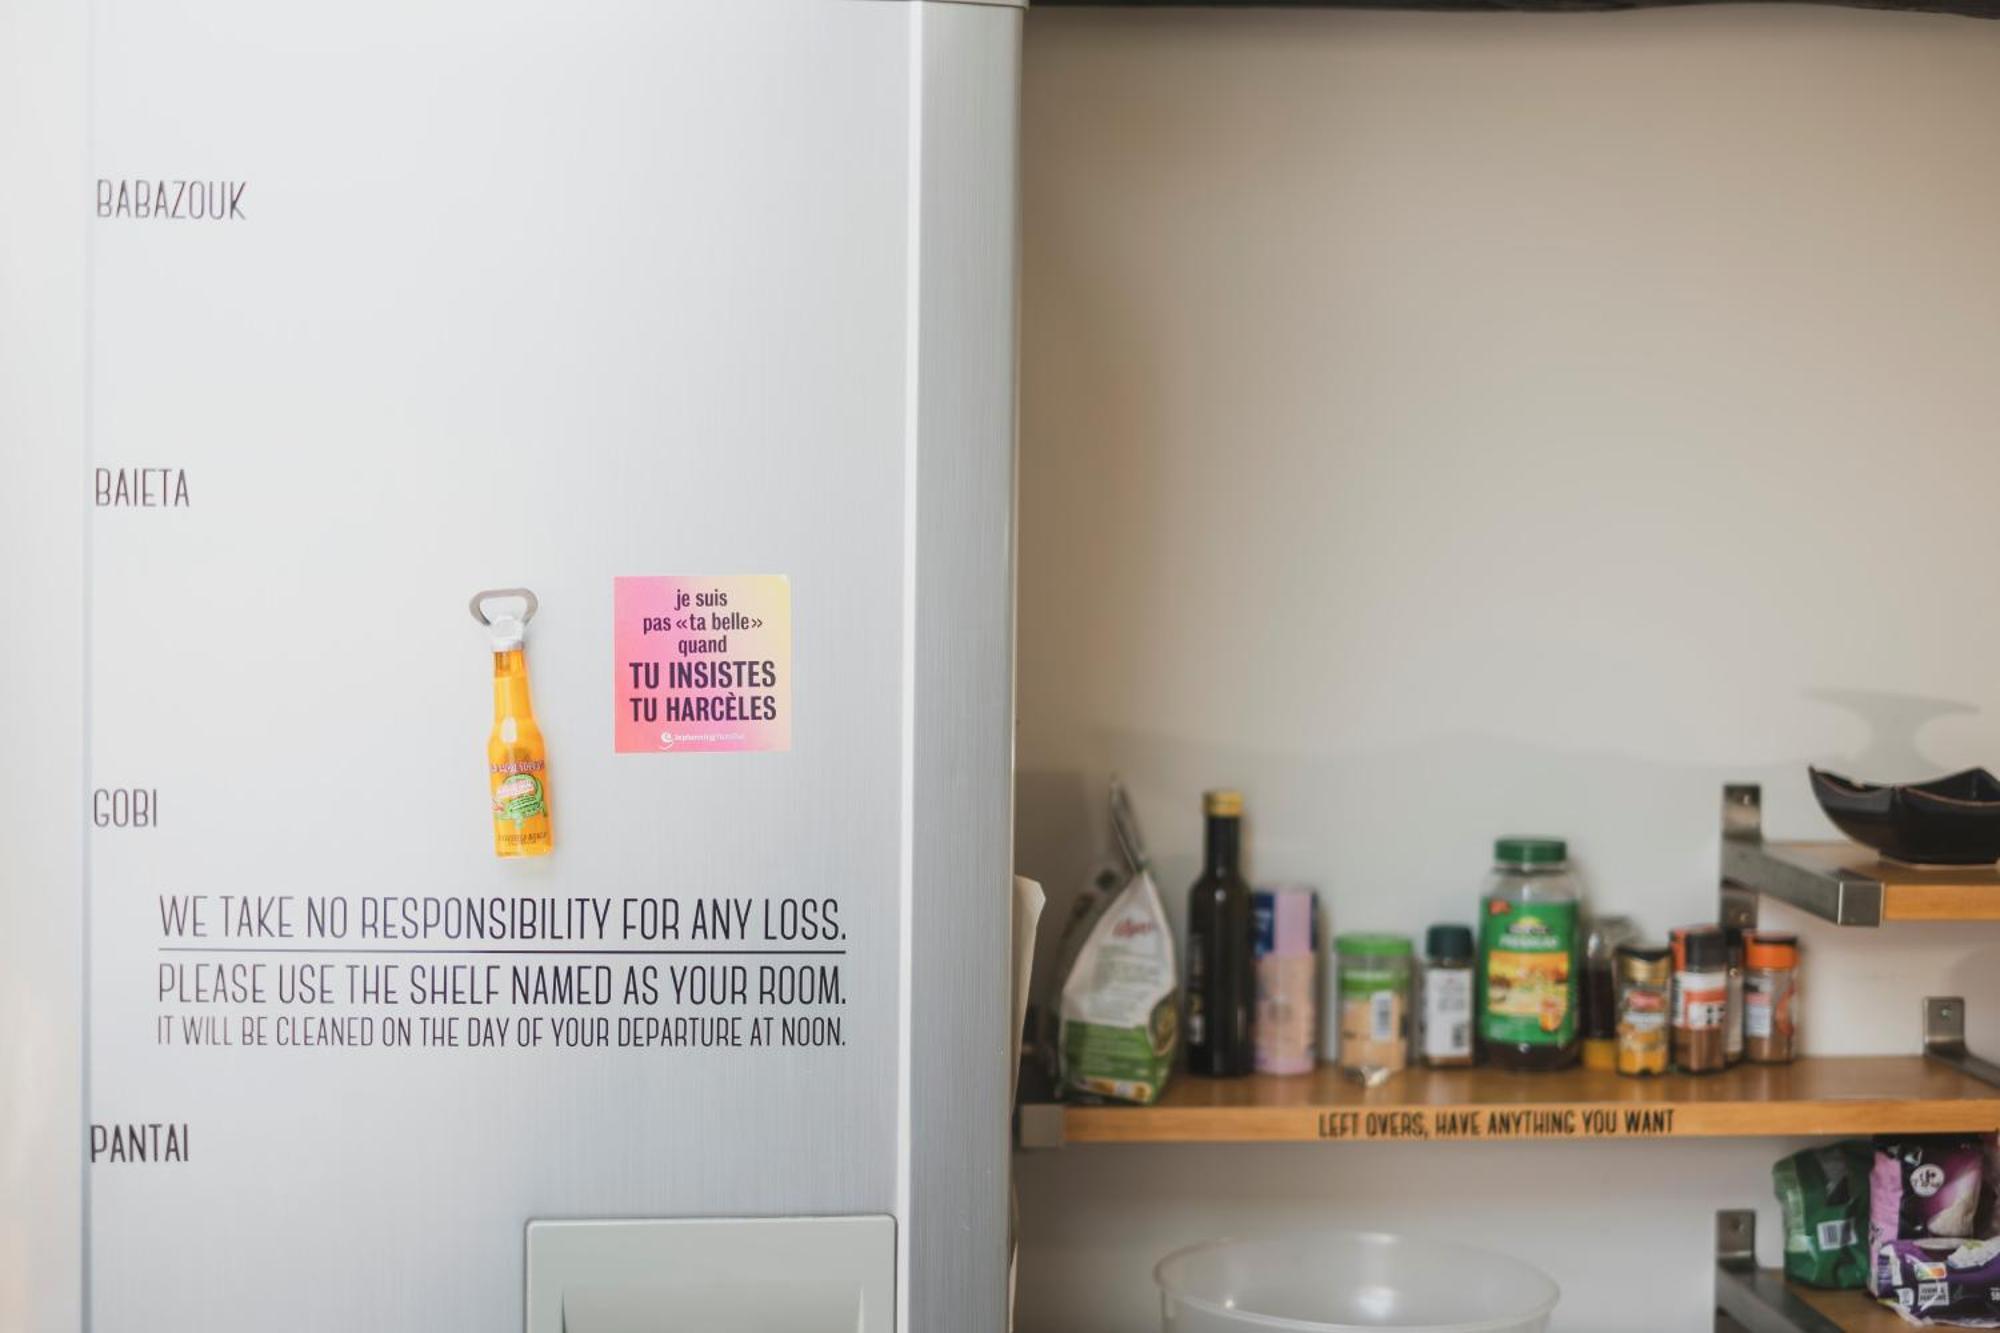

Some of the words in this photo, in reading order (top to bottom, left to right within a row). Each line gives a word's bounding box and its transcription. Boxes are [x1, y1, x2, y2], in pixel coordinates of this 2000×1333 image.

[97, 179, 247, 220] BABAZOUK
[95, 467, 190, 508] BAIETA
[674, 589, 691, 611] je
[695, 588, 728, 607] suis
[643, 615, 672, 635] pas
[676, 612, 707, 632] «ta
[711, 612, 763, 632] belle»
[678, 635, 728, 657] quand
[629, 661, 660, 690] TU
[669, 660, 776, 689] INSISTES
[629, 696, 658, 723] TU
[666, 692, 777, 722] HARCÈLES
[93, 788, 158, 828] GOBI
[160, 895, 208, 937] WE
[220, 896, 294, 938] TAKE
[307, 896, 347, 939] NO
[362, 896, 613, 940] RESPONSIBILITY
[623, 898, 679, 940] FOR
[691, 898, 752, 940] ANY
[764, 898, 846, 940] LOSS.
[159, 963, 266, 1003] PLEASE
[279, 964, 335, 1004] USE
[346, 964, 399, 1004] THE
[410, 965, 501, 1005] SHELF
[512, 965, 612, 1006] NAMED
[623, 965, 659, 1006] AS
[669, 965, 747, 1006] YOUR
[759, 965, 846, 1006] ROOM.
[158, 1015, 173, 1045] IT
[182, 1016, 232, 1045] WILL
[242, 1016, 268, 1046] BE
[277, 1016, 373, 1046] CLEANED
[382, 1017, 411, 1047] ON
[419, 1017, 459, 1047] THE
[468, 1017, 509, 1047] DAY
[517, 1017, 544, 1047] OF
[550, 1017, 609, 1047] YOUR
[618, 1017, 742, 1047] DEPARTURE
[750, 1017, 775, 1047] AT
[782, 1017, 846, 1047] NOON.
[1319, 1111, 1359, 1137] LEFT
[1366, 1111, 1428, 1140] OVERS,
[1436, 1111, 1480, 1136] HAVE
[1488, 1110, 1575, 1135] ANYTHING
[1582, 1109, 1617, 1134] YOU
[1624, 1108, 1674, 1134] WANT
[90, 1123, 189, 1163] PANTAI
